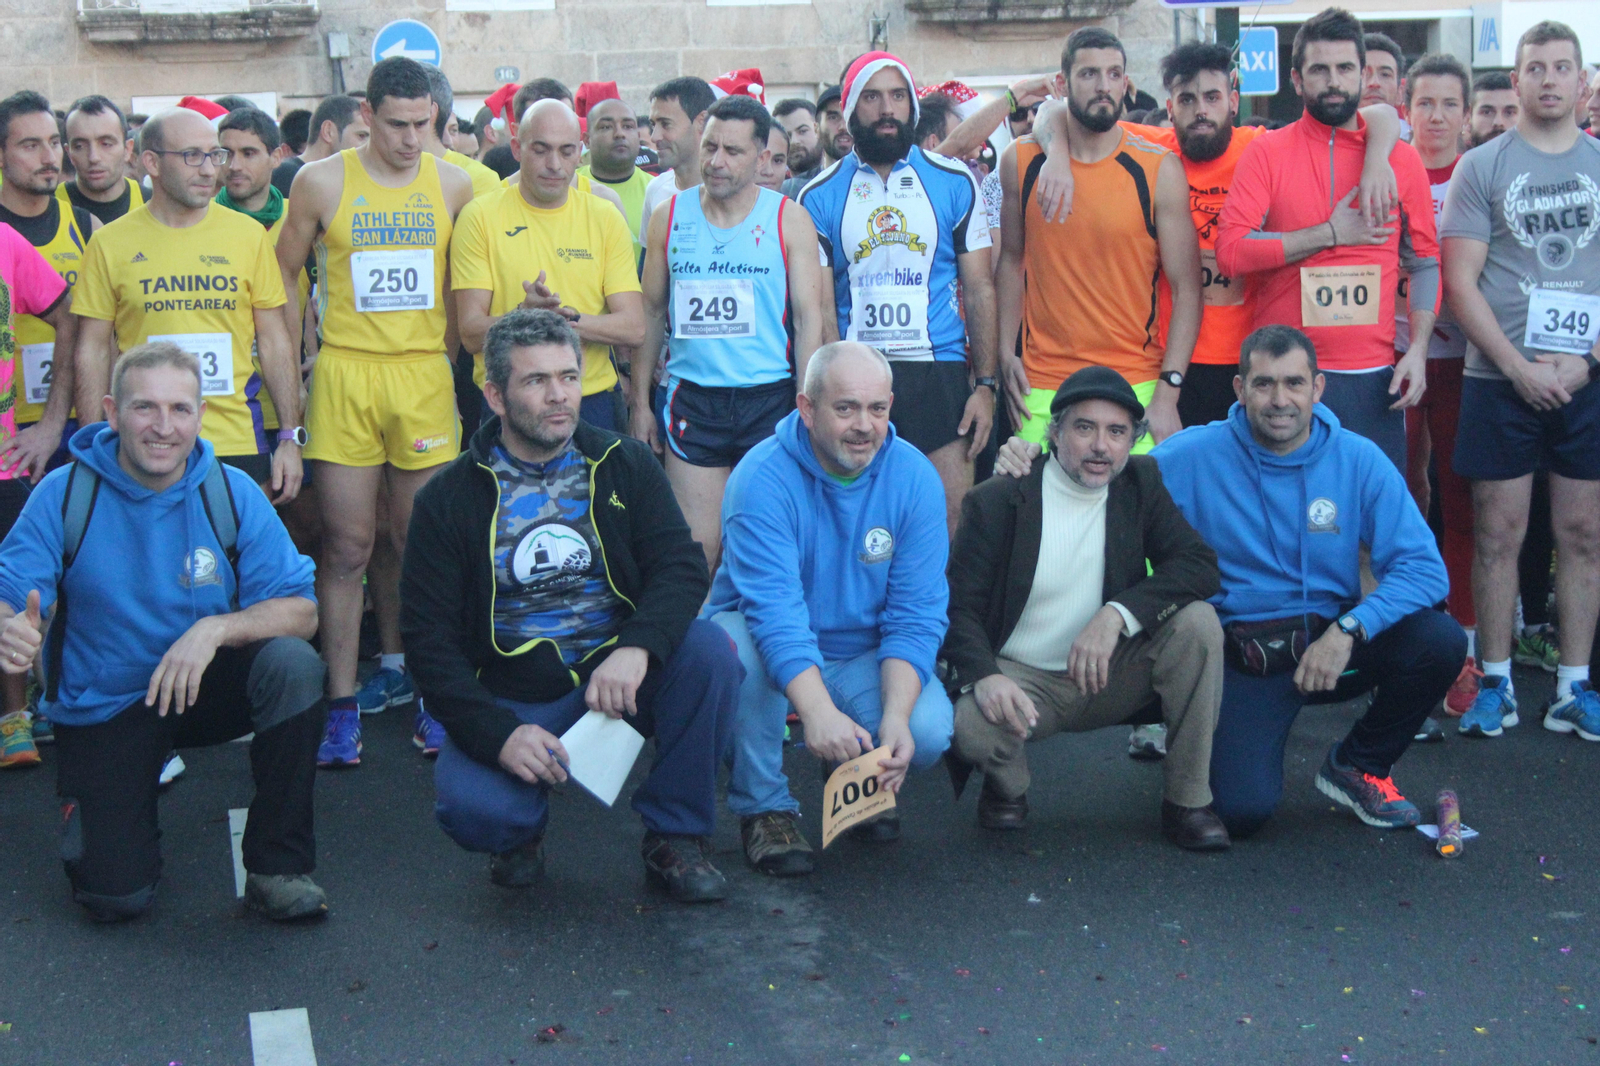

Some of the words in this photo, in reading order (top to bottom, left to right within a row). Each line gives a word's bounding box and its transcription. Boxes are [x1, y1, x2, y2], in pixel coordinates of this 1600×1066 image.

[1239, 50, 1274, 72] AXI
[1521, 186, 1526, 197] I
[1528, 180, 1580, 196] FINISHED
[1516, 190, 1592, 214] GLADIATOR
[351, 212, 436, 228] ATHLETICS
[1523, 206, 1590, 235] RACE
[352, 231, 382, 246] SAN
[384, 228, 436, 246] LÁZARO
[671, 262, 701, 274] Celta
[708, 261, 770, 275] Atletismo
[857, 267, 923, 288] xtrembike
[139, 274, 238, 295] TANINOS
[368, 267, 419, 294] 250
[1542, 280, 1585, 289] RENAULT
[144, 298, 237, 313] PONTEAREAS
[1316, 284, 1368, 307] 010
[688, 296, 738, 321] 249
[864, 302, 912, 328] 300
[1543, 307, 1590, 336] 349
[831, 775, 878, 818] 007
